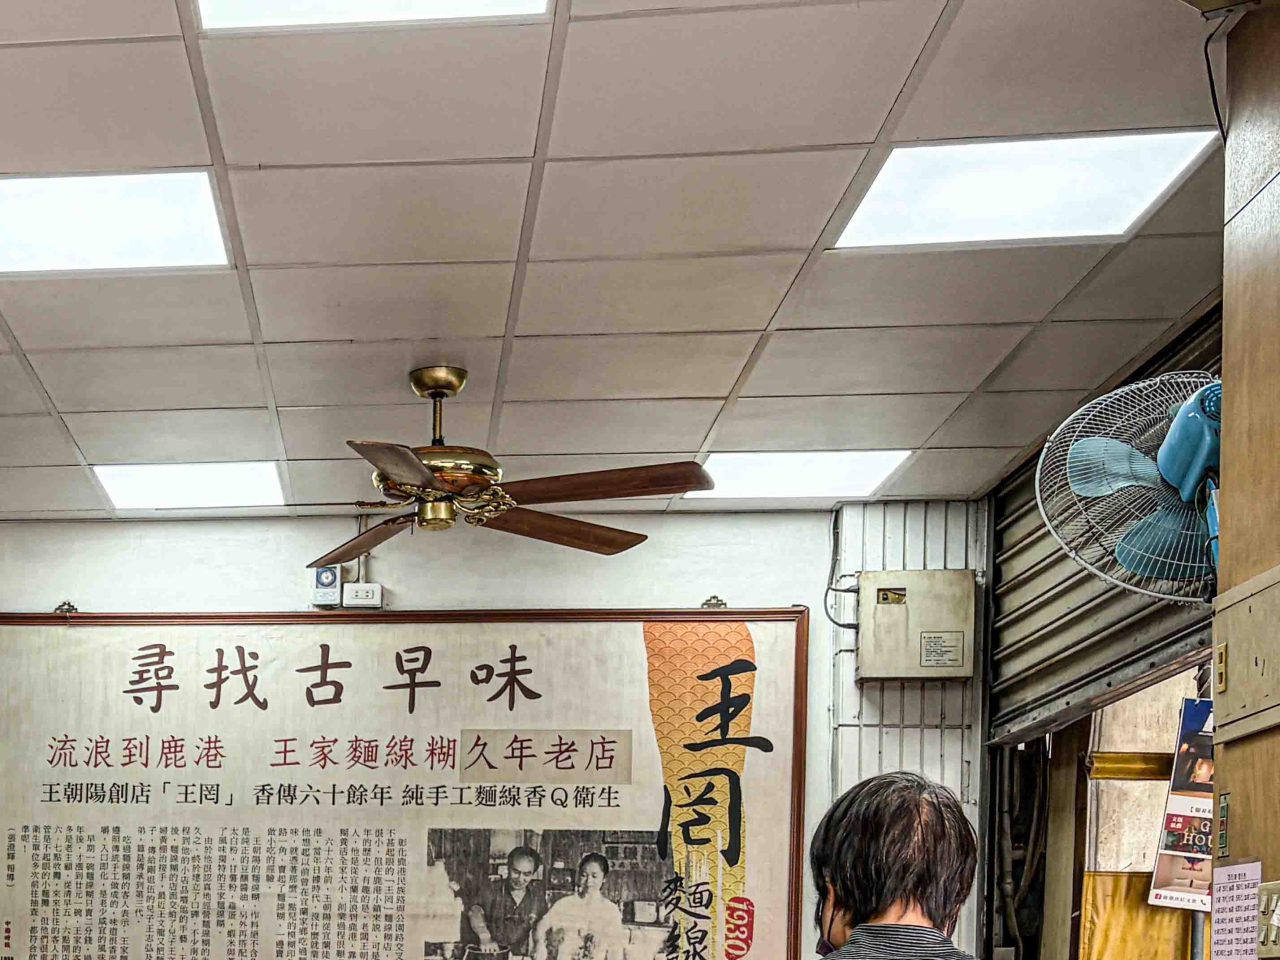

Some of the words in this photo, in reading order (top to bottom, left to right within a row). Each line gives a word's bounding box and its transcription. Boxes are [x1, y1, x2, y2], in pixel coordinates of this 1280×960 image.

[122, 643, 543, 714] 尋找古早味
[46, 733, 228, 769] 流浪到鹿港
[270, 733, 617, 771] 王家麵線糊久年老店
[253, 783, 393, 807] 香傳六十餘年
[726, 899, 754, 957] 1930
